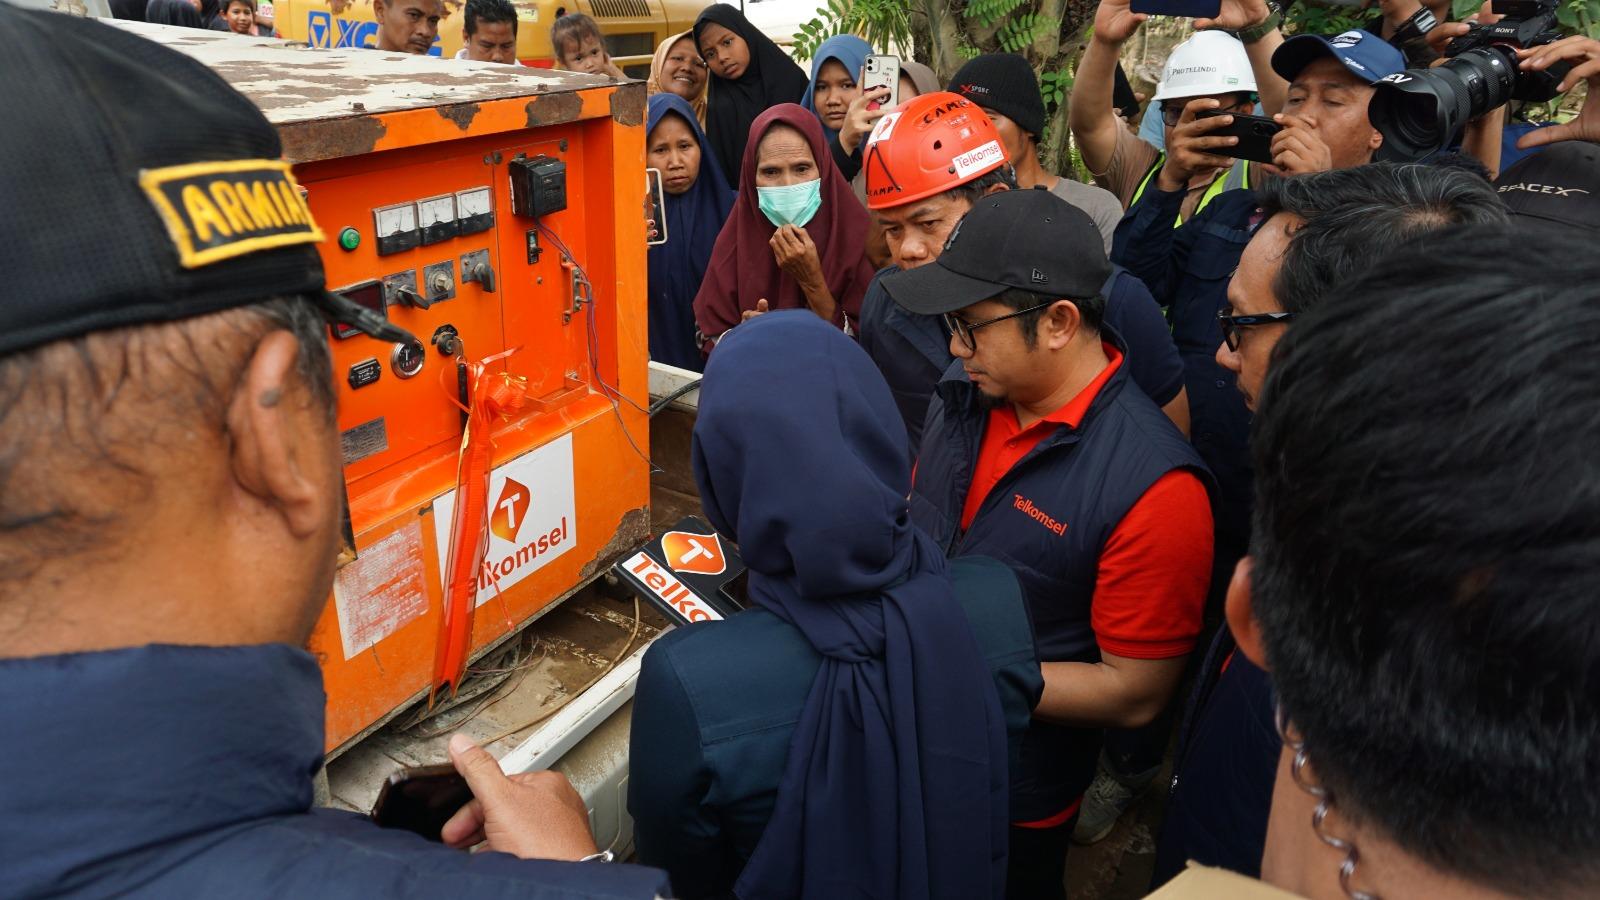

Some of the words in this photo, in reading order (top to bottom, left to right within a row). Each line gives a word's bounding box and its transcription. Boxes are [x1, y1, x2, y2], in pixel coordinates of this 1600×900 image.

[955, 144, 1000, 168] Telkomse
[1497, 183, 1590, 197] SPACEX
[1013, 494, 1067, 536] Telkomsel
[450, 516, 567, 598] elkomsel
[632, 552, 712, 622] Telko
